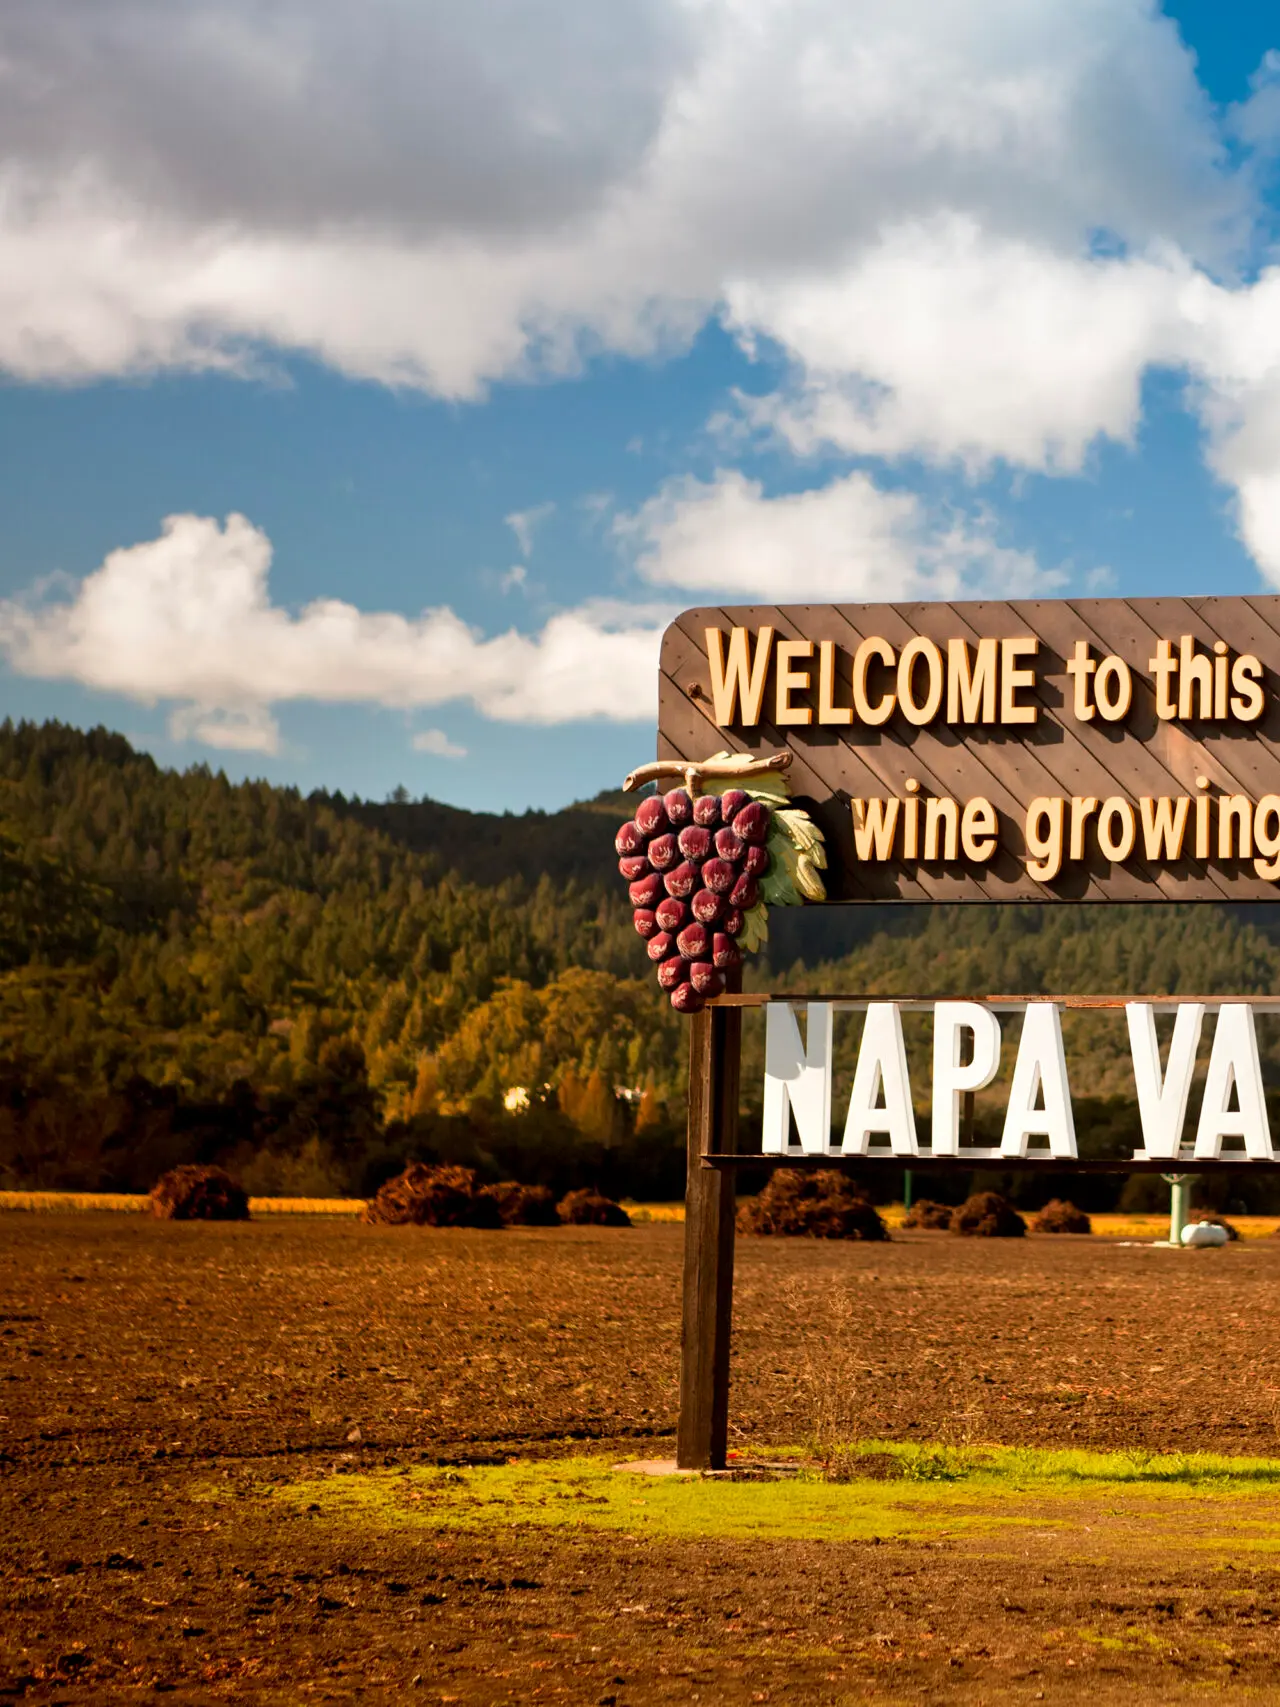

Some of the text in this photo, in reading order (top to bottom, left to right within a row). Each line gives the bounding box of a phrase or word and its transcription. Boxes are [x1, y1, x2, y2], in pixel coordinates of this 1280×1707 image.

[705, 626, 1039, 727] WELCOME
[1066, 640, 1132, 721] to
[1149, 635, 1264, 721] this
[852, 778, 999, 863] wine
[762, 1001, 1079, 1158] NAPA
